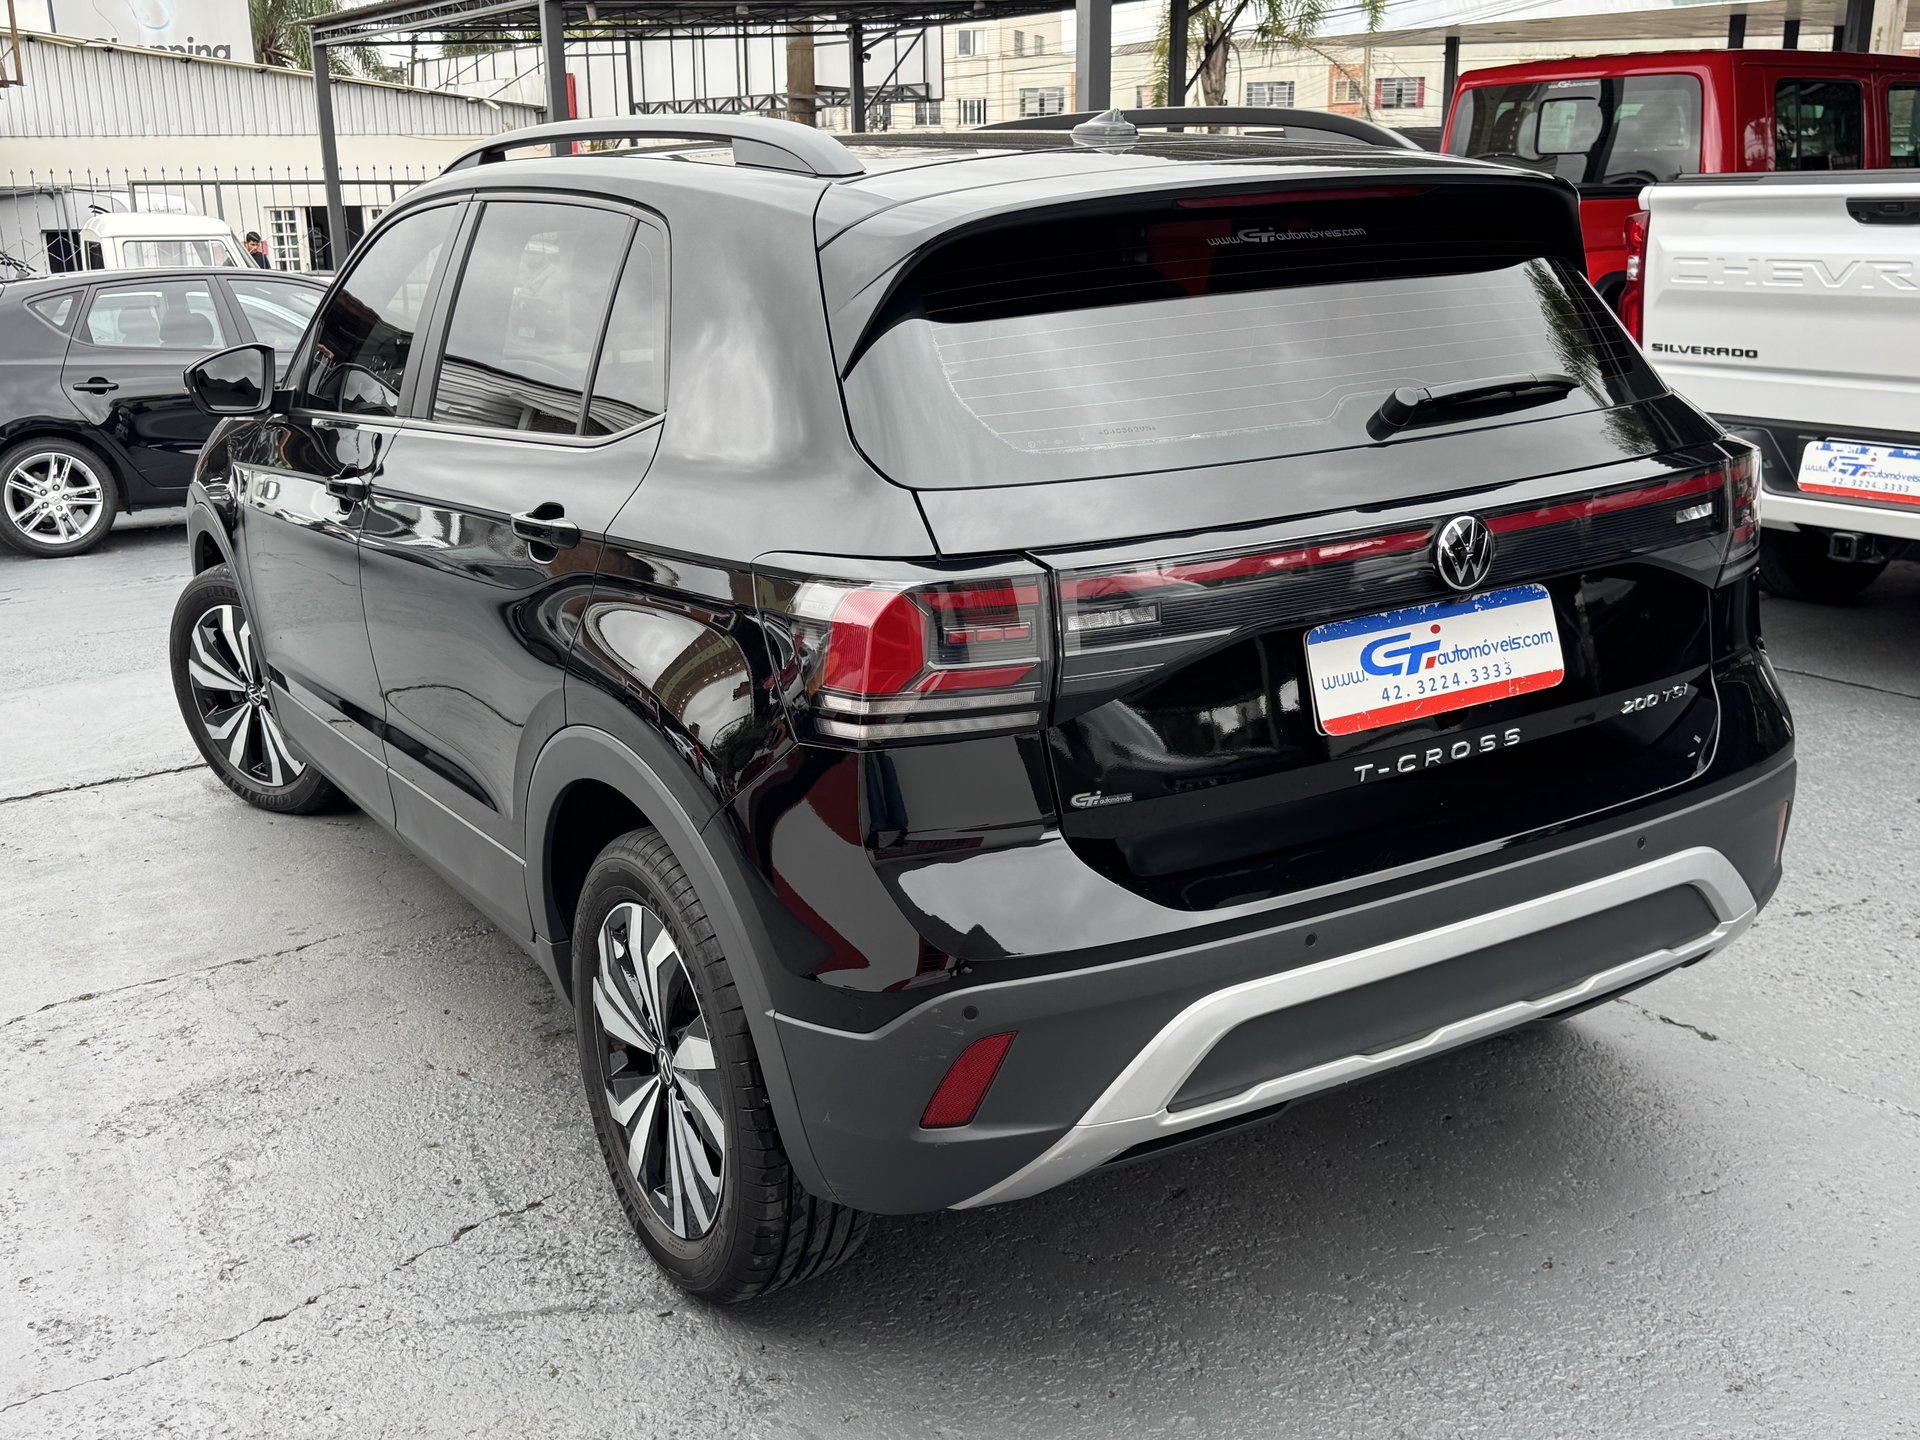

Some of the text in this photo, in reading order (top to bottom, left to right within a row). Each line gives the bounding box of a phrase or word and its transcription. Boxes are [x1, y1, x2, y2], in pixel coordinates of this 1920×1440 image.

[1651, 342, 1759, 359] SILVERADO
[1381, 661, 1512, 702] 42.3224.3333
[1620, 682, 1688, 714] 200 TSI
[1353, 728, 1521, 782] T-CROSS
